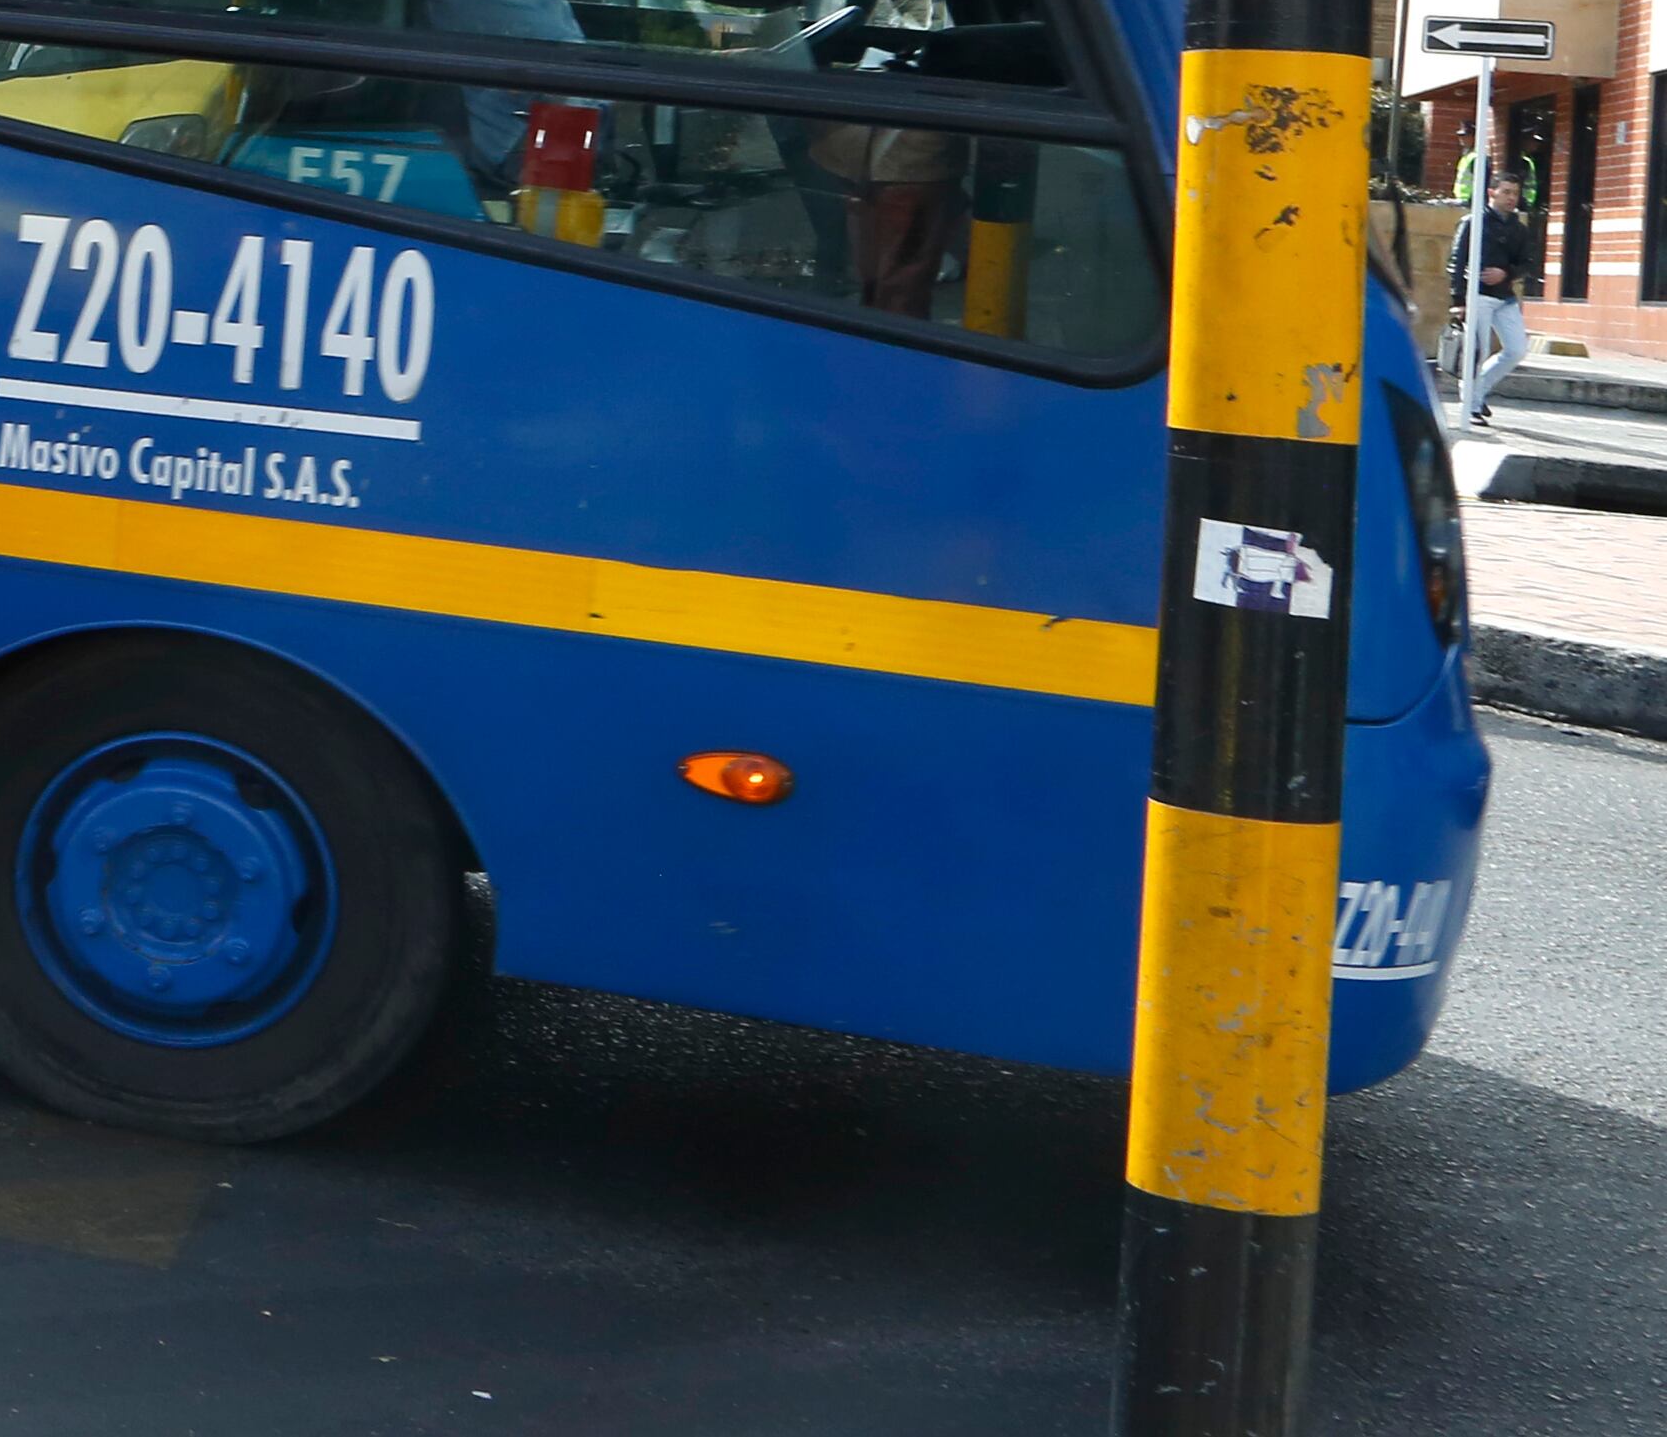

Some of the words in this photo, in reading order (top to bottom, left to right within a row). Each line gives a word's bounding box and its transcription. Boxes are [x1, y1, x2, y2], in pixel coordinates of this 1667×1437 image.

[8, 214, 435, 403] Z20-4140
[129, 437, 257, 500] Capital
[263, 452, 360, 509] S.A.S.
